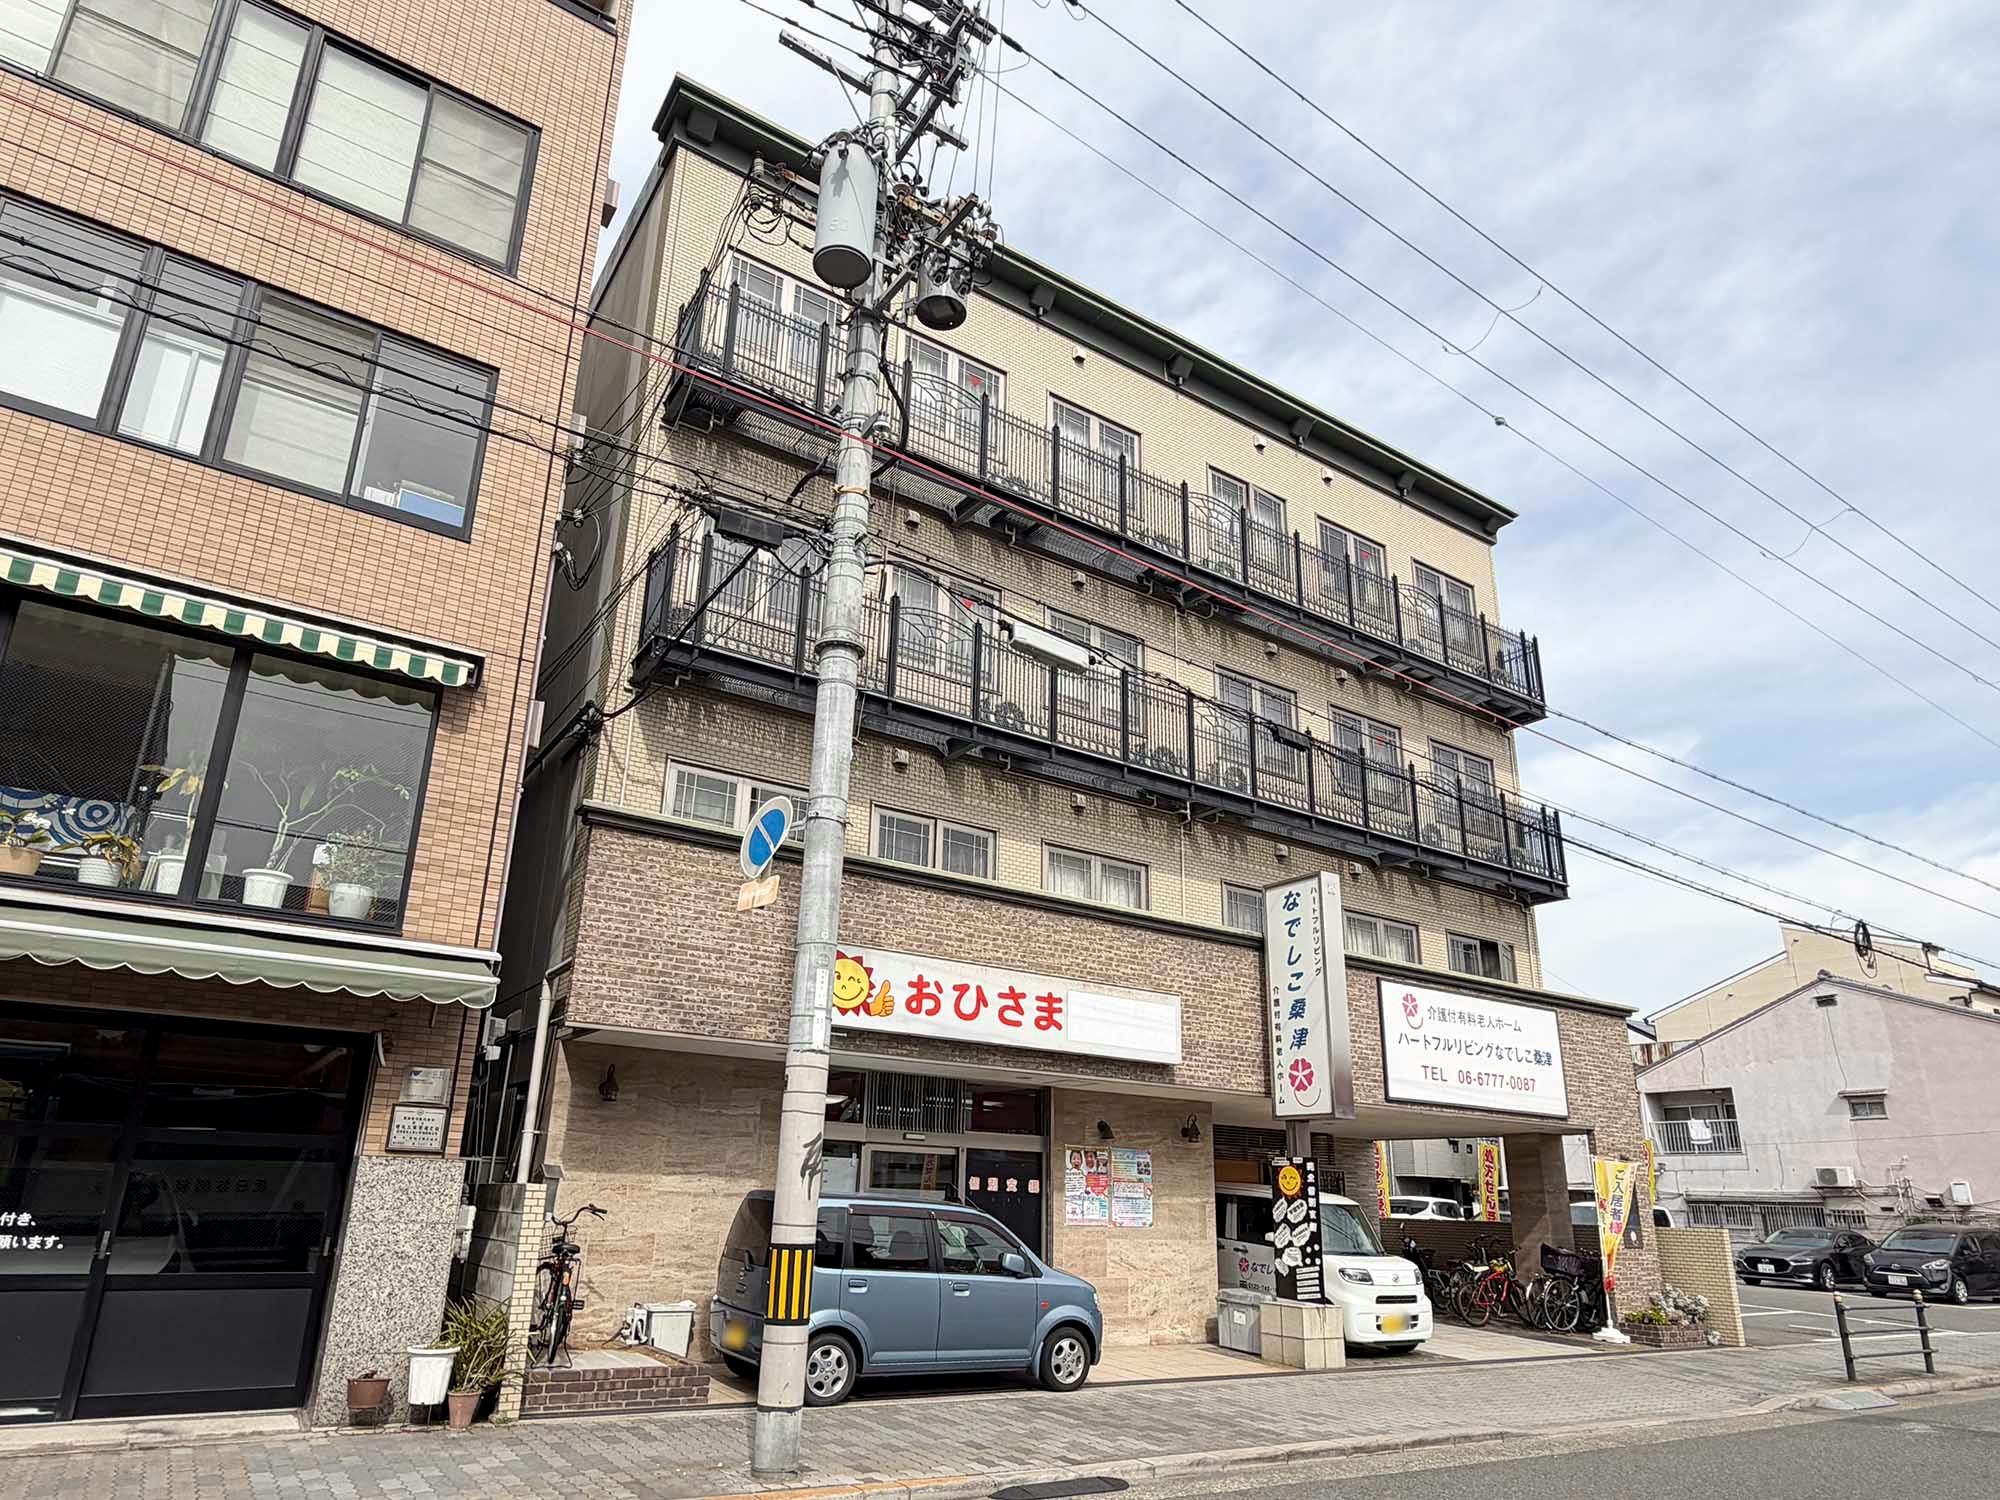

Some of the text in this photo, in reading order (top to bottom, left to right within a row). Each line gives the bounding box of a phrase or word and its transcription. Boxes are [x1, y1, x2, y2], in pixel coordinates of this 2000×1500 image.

[1310, 886, 1323, 977] ハートフルリビング
[1282, 889, 1310, 1051] なでしこ桑津
[904, 973, 1064, 1032] おひさま
[1427, 1004, 1522, 1033] 介護付有料老人ホーム
[1398, 1032, 1553, 1067] ハートフルリビングなでしこ桑津
[1421, 1064, 1449, 1082] TEL
